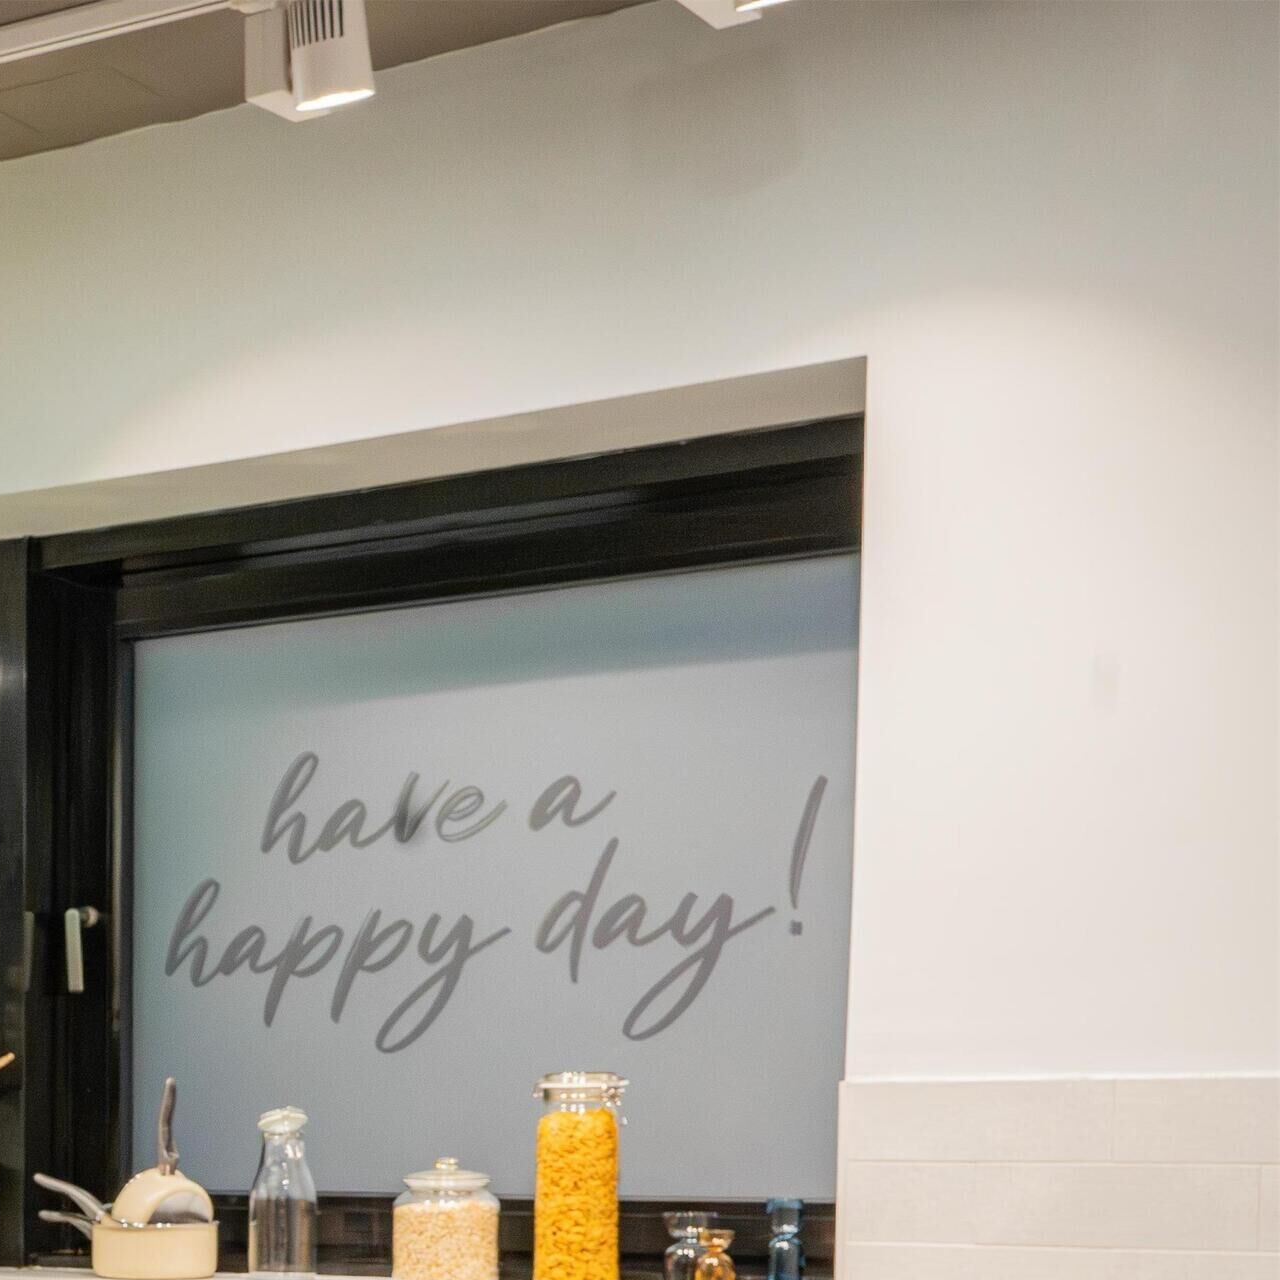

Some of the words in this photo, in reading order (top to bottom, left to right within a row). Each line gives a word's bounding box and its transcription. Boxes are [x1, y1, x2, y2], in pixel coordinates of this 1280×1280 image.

[260, 750, 508, 865] have
[528, 774, 617, 831] a
[164, 878, 512, 1054] happy
[534, 775, 828, 1042] day!
